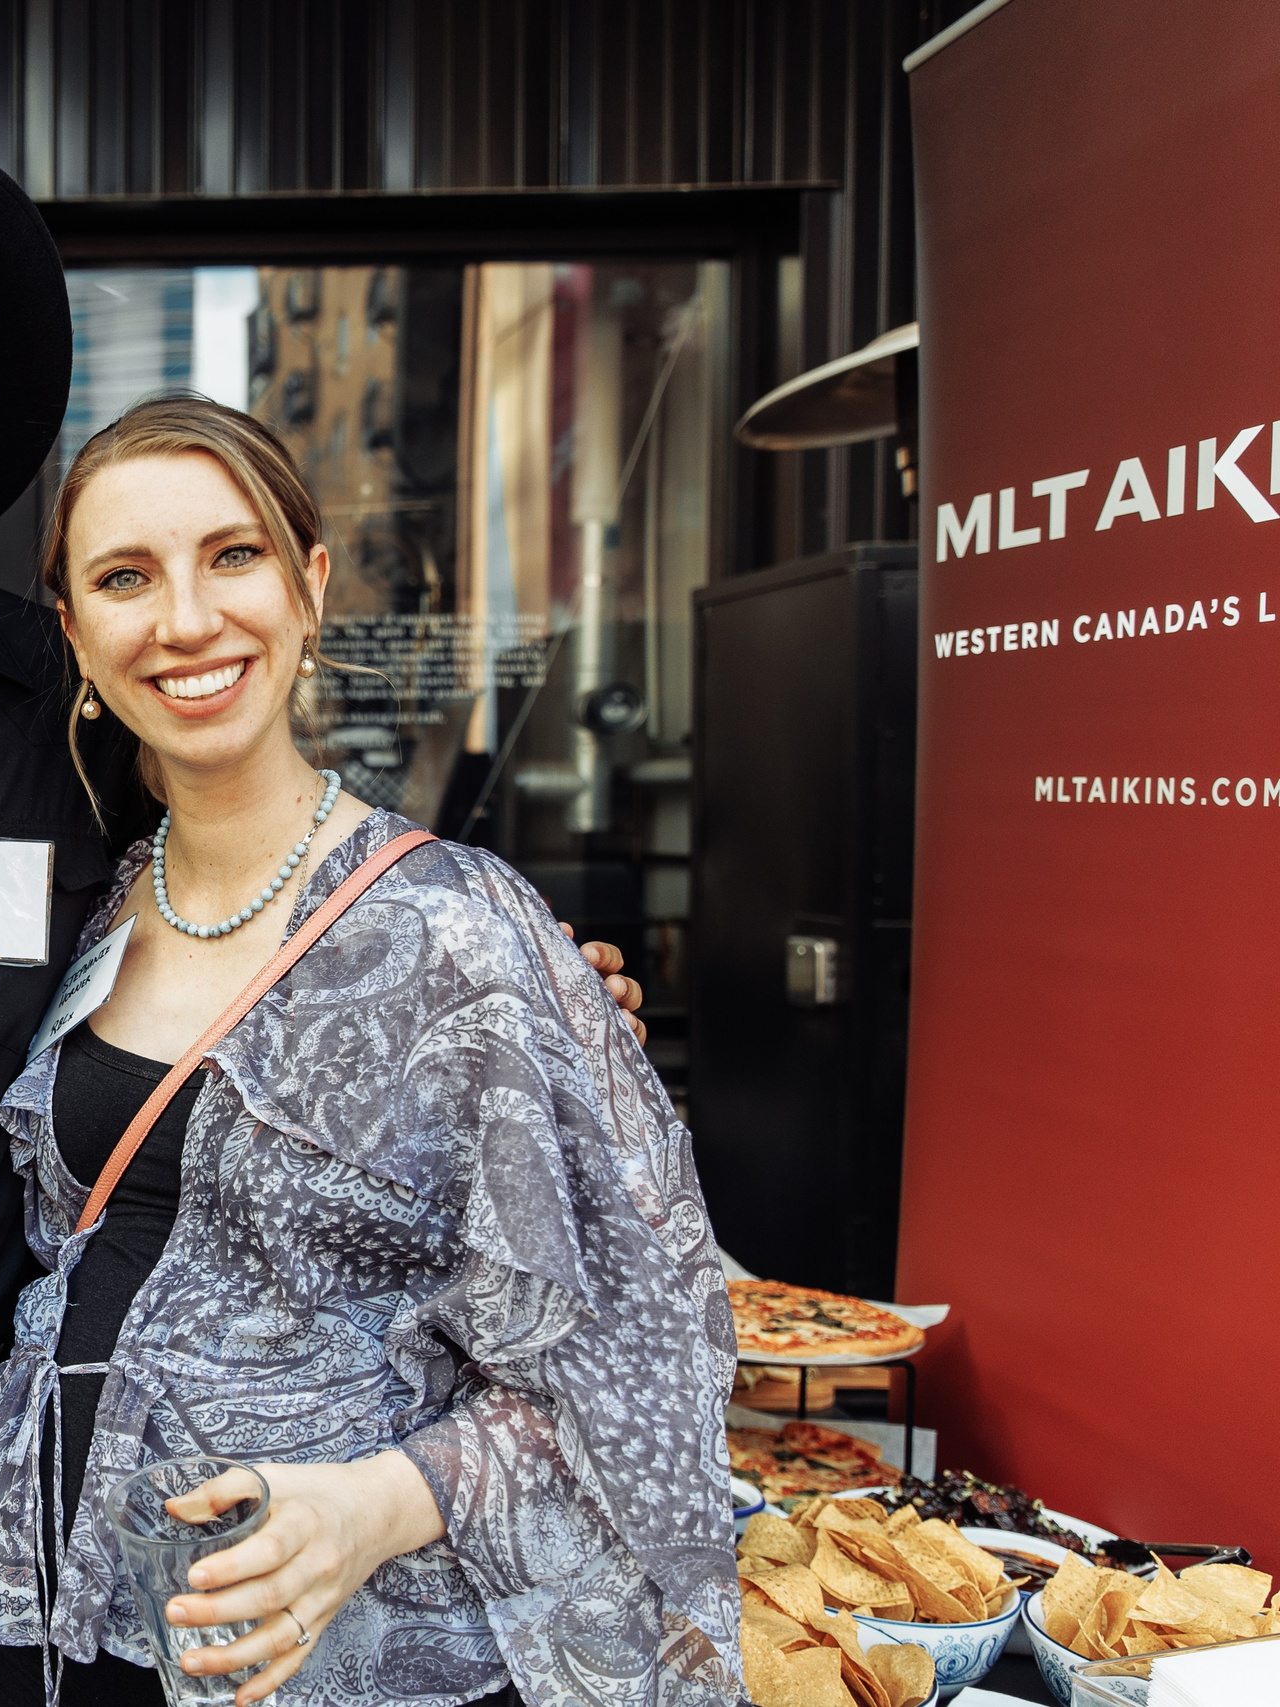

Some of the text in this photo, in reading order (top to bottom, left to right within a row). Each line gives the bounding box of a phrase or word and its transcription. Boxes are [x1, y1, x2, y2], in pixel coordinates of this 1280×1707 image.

[936, 469, 1090, 563] MLT
[934, 618, 1060, 659] WESTERN
[1072, 596, 1241, 644] CANADA’S
[1034, 776, 1280, 807] MLTAIKINS.COM
[62, 944, 111, 993] STEPHANIE
